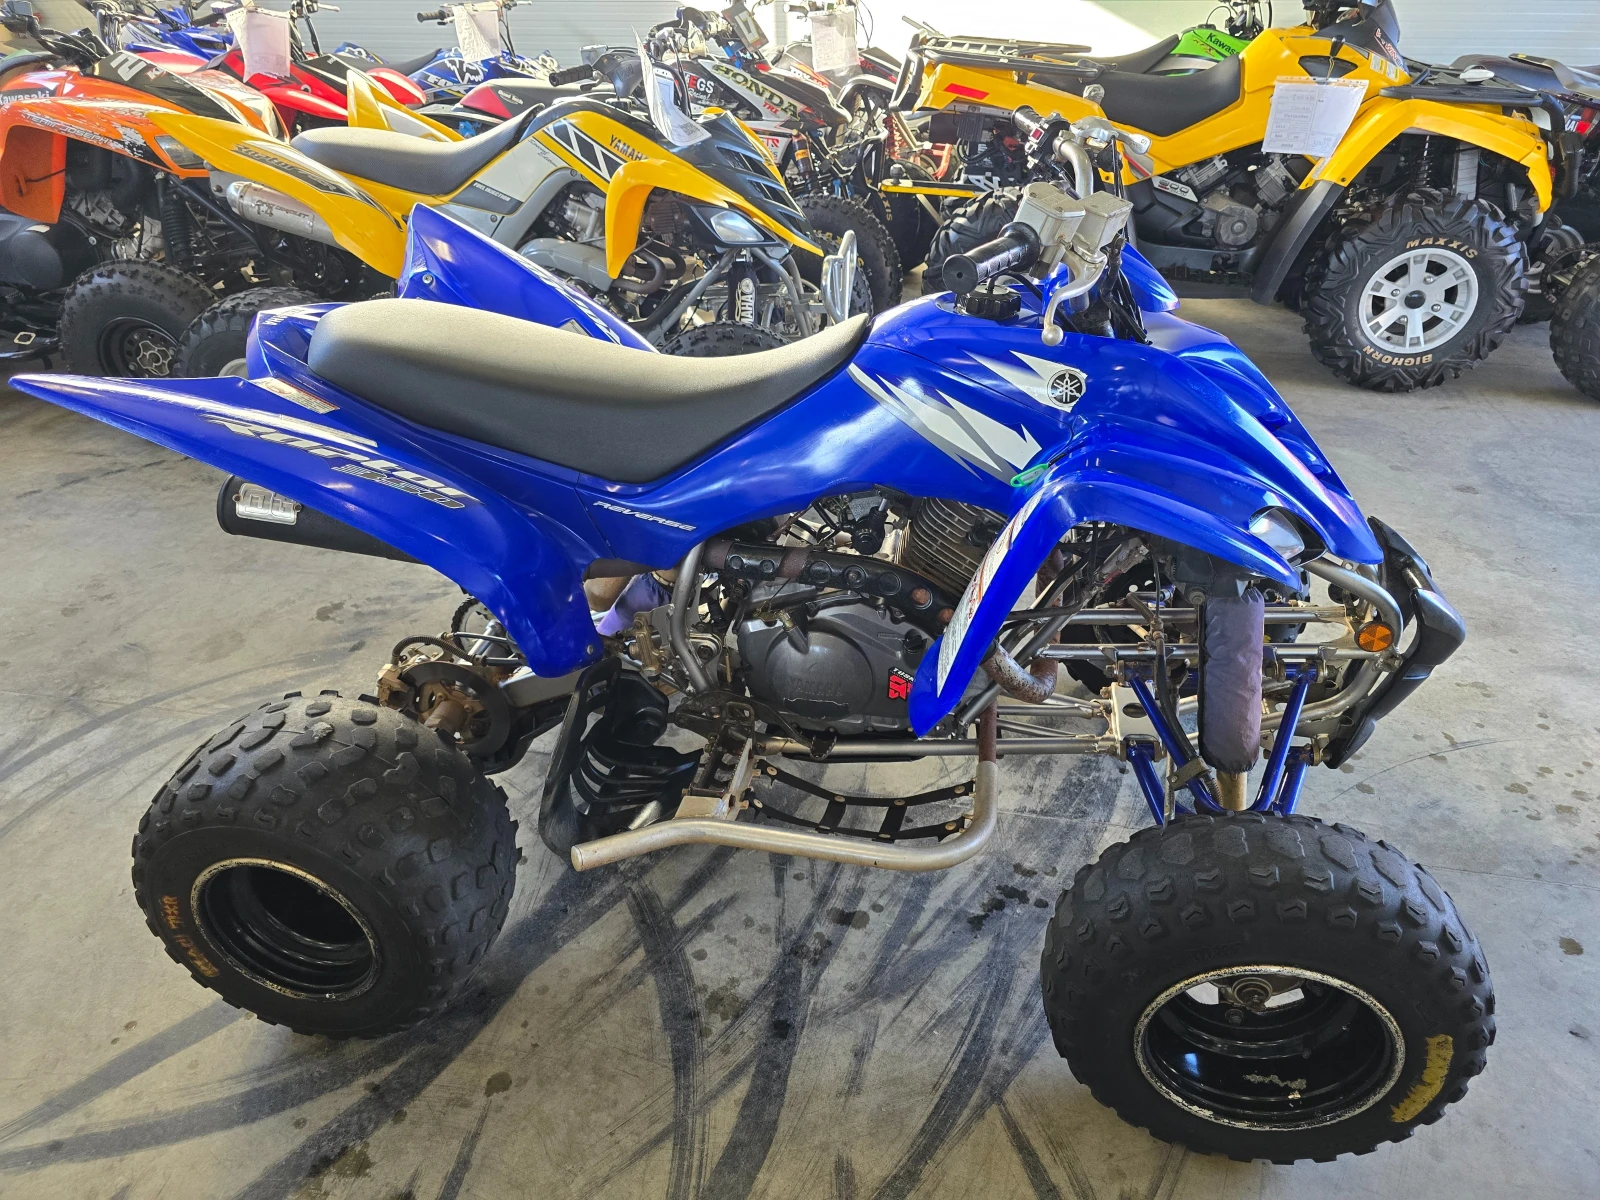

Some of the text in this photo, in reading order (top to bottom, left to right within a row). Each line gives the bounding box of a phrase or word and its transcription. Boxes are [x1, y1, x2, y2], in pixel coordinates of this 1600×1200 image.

[711, 63, 800, 121] HONDA
[762, 101, 780, 114] TRX
[609, 134, 650, 162] YAMAH
[473, 182, 511, 202] FUEL INJECTION
[1405, 236, 1478, 260] MAXXIS
[1363, 344, 1433, 366] BIGHORN
[592, 500, 697, 532] REVERSE
